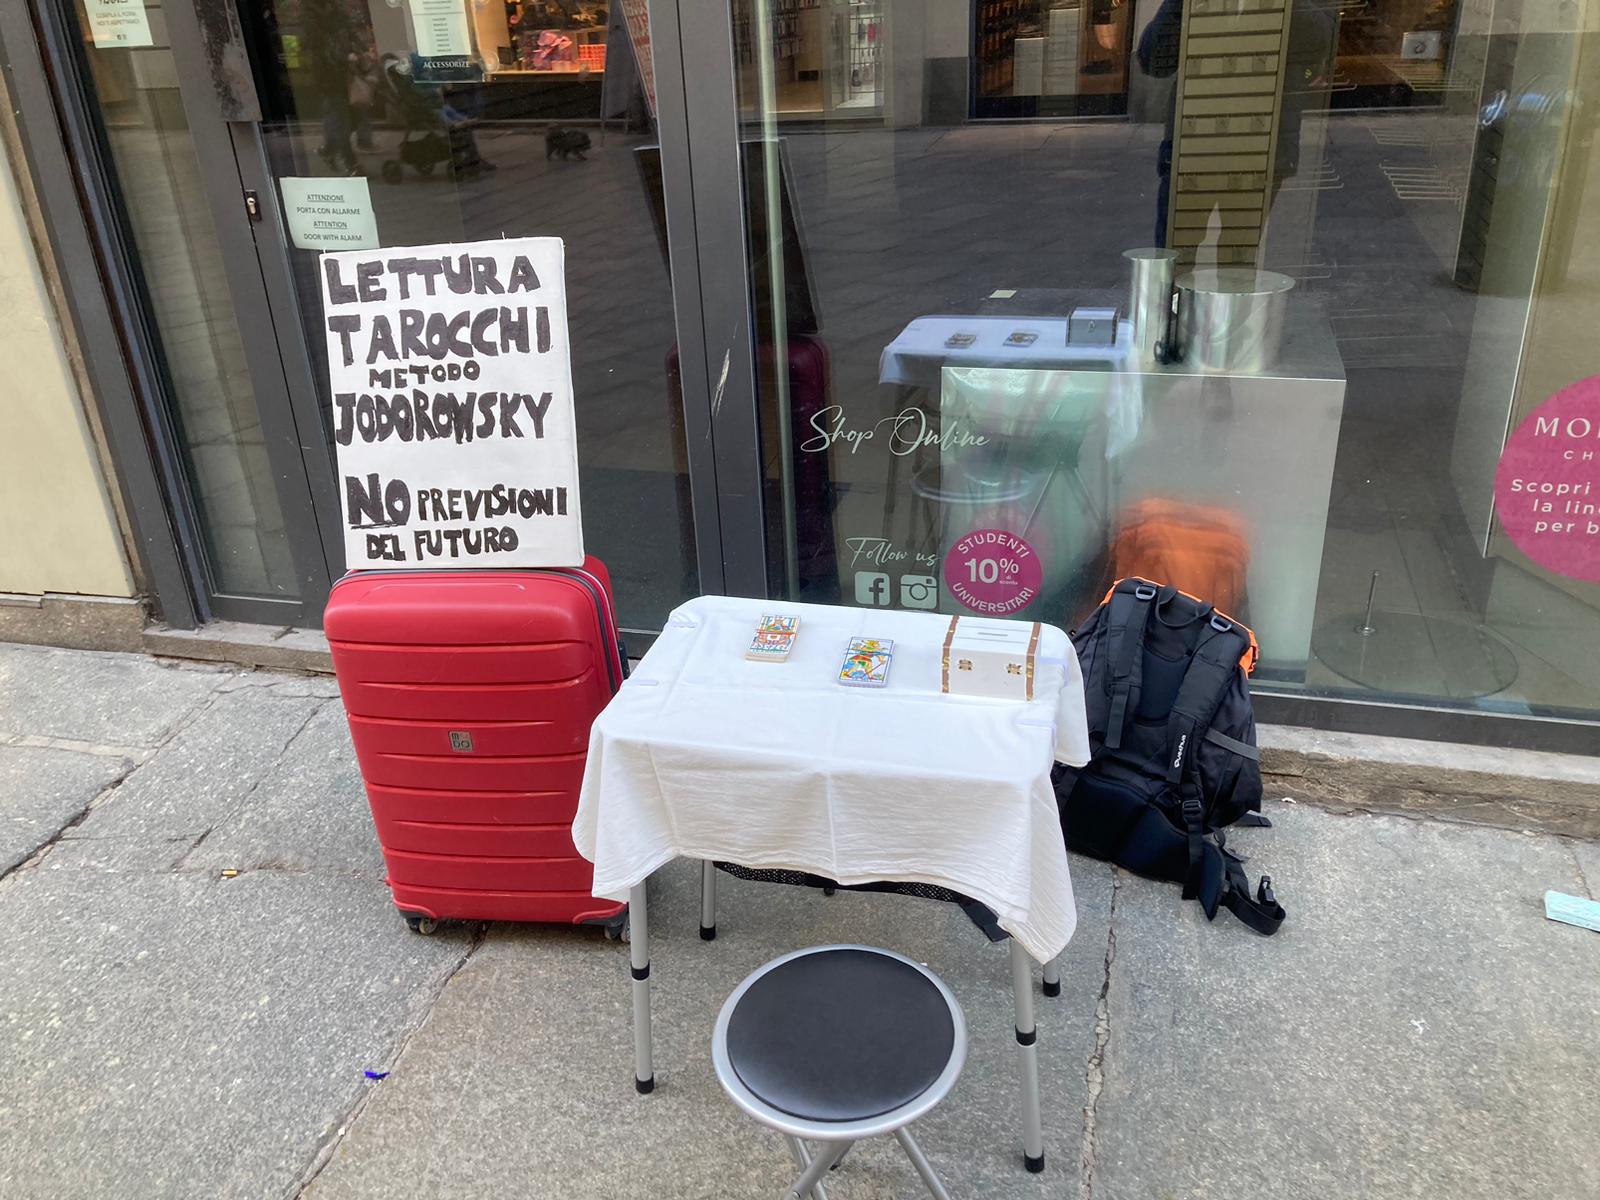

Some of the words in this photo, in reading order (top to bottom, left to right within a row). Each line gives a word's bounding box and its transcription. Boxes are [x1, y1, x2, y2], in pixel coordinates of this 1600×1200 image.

[423, 61, 470, 69] ACCESSORIZE
[307, 194, 345, 202] ATTENZIONE
[313, 220, 347, 229] ATTENTION
[324, 253, 541, 305] LETTURA
[328, 306, 553, 368] TAROCCHI
[369, 360, 480, 389] METODO
[335, 389, 552, 446] JODOROWSKY
[801, 405, 874, 454] Shop
[874, 407, 990, 456] Online
[1535, 417, 1600, 438] MO
[345, 473, 411, 527] NO
[417, 484, 567, 522] PREVISIONI
[1511, 479, 1591, 496] Scopri
[1533, 499, 1553, 512] la
[1565, 501, 1600, 515] lin
[1535, 521, 1575, 533] per
[366, 534, 406, 561] DEL
[414, 526, 519, 561] FUTURO
[845, 537, 907, 568] Follow
[916, 551, 939, 567] us
[958, 533, 1029, 558] STUDENTI
[964, 558, 1019, 583] 10%
[953, 582, 1034, 613] UNIVERSITARI
